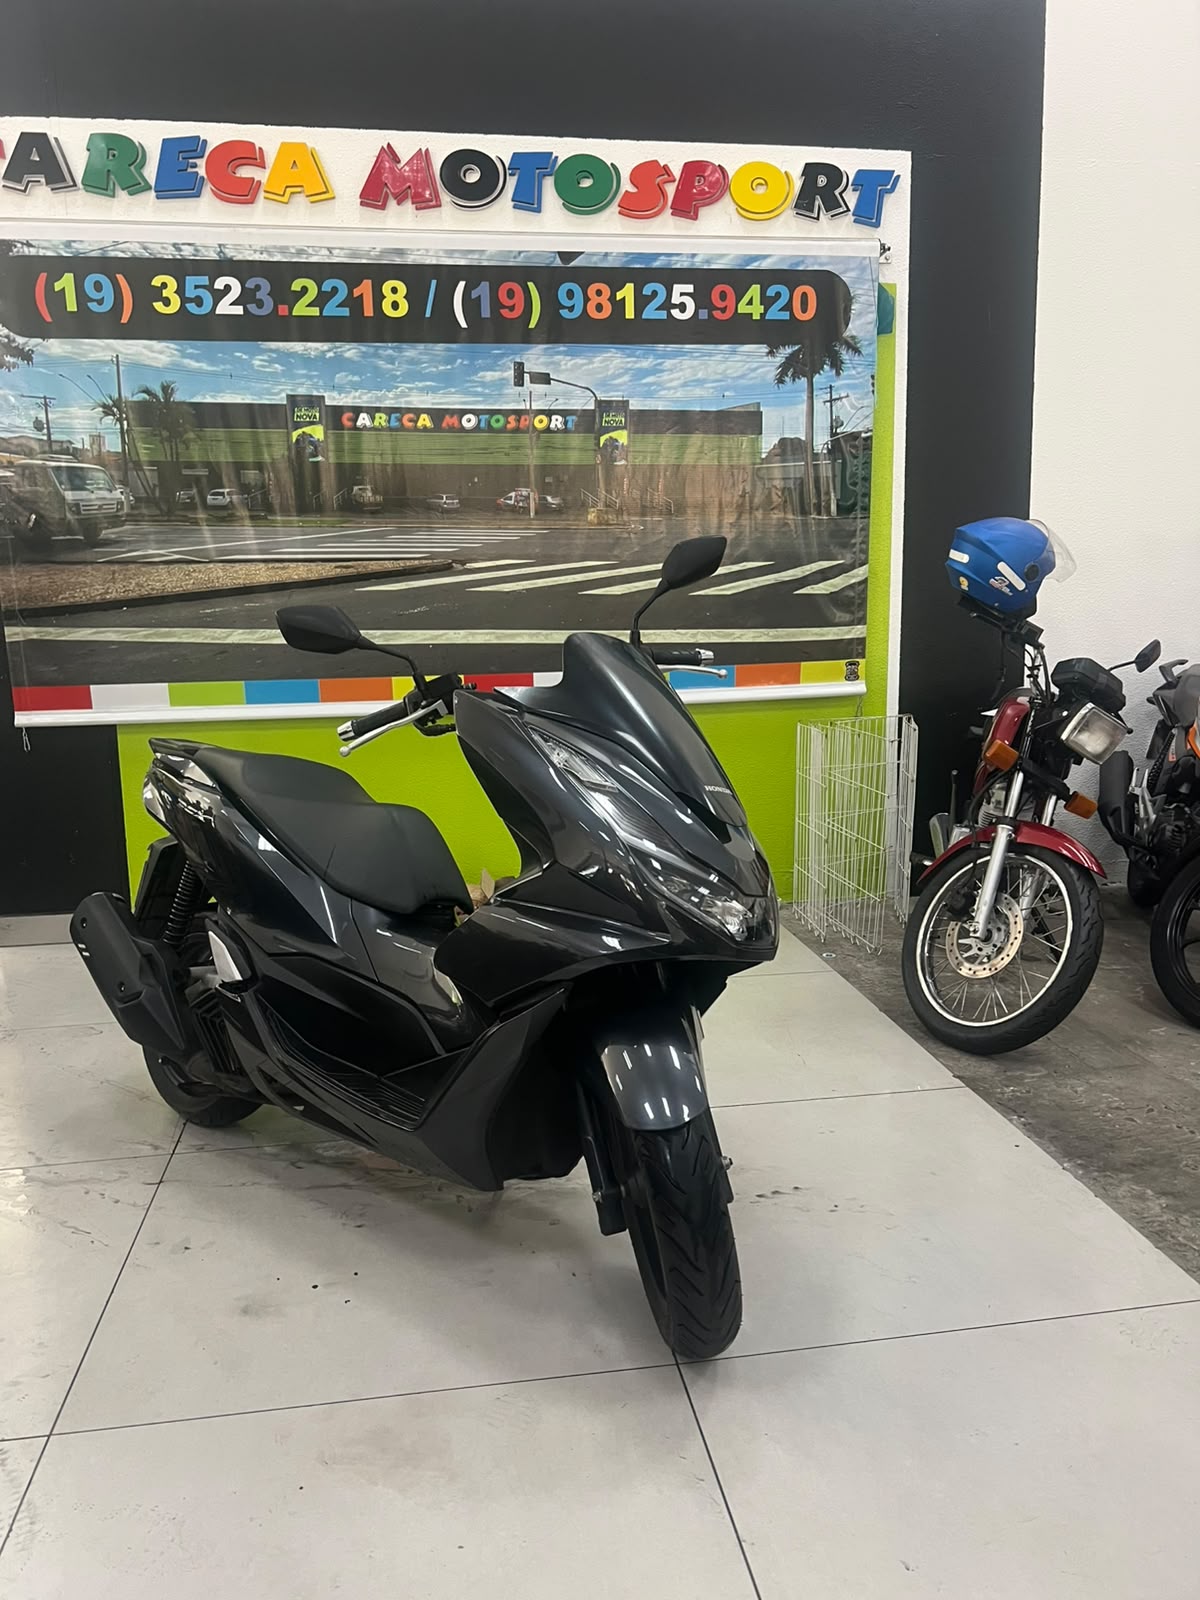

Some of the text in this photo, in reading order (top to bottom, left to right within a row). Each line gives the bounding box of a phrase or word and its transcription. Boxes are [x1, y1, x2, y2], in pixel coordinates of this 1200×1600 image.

[0, 131, 901, 228] ARECA MOTOSPORT
[34, 272, 818, 329] (19) 3523.2218 / (19) 98125.9420
[340, 412, 578, 431] CARECA MOTOSPORT
